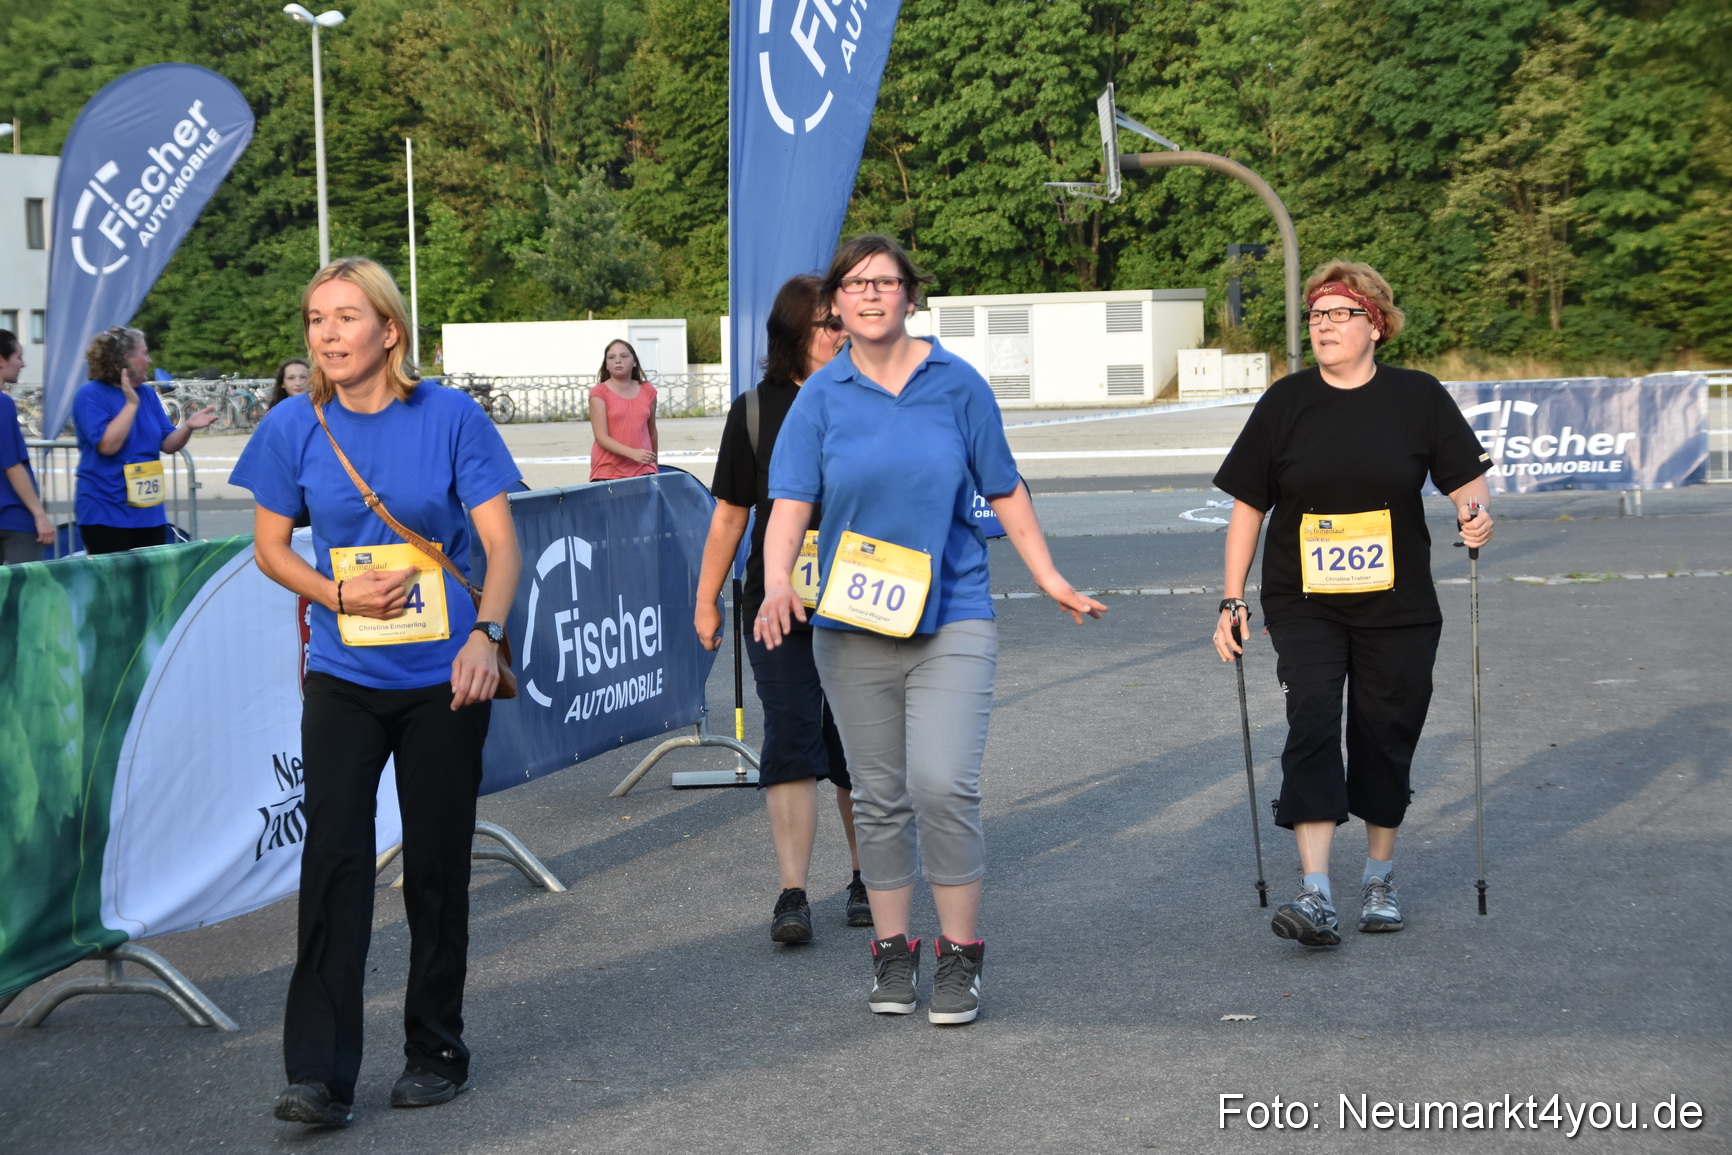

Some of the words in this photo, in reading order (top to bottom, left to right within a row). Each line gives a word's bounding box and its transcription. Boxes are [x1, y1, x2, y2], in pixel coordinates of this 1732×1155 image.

[98, 99, 209, 250] Fischer
[138, 128, 221, 248] AUTOMOBILE
[1474, 426, 1635, 459] Fischer
[1485, 460, 1622, 477] AUTOMOBILE
[136, 479, 159, 495] 726
[348, 562, 388, 572] firmenlauf
[1311, 543, 1384, 571] 1262
[800, 562, 820, 586] 1
[847, 572, 906, 611] 810
[359, 624, 390, 632] Christine
[390, 621, 427, 631] Emmerling
[848, 605, 871, 617] Tamara
[869, 611, 891, 622] Wagner
[564, 668, 663, 723] AUTOMOBILE
[272, 751, 304, 791] Ne
